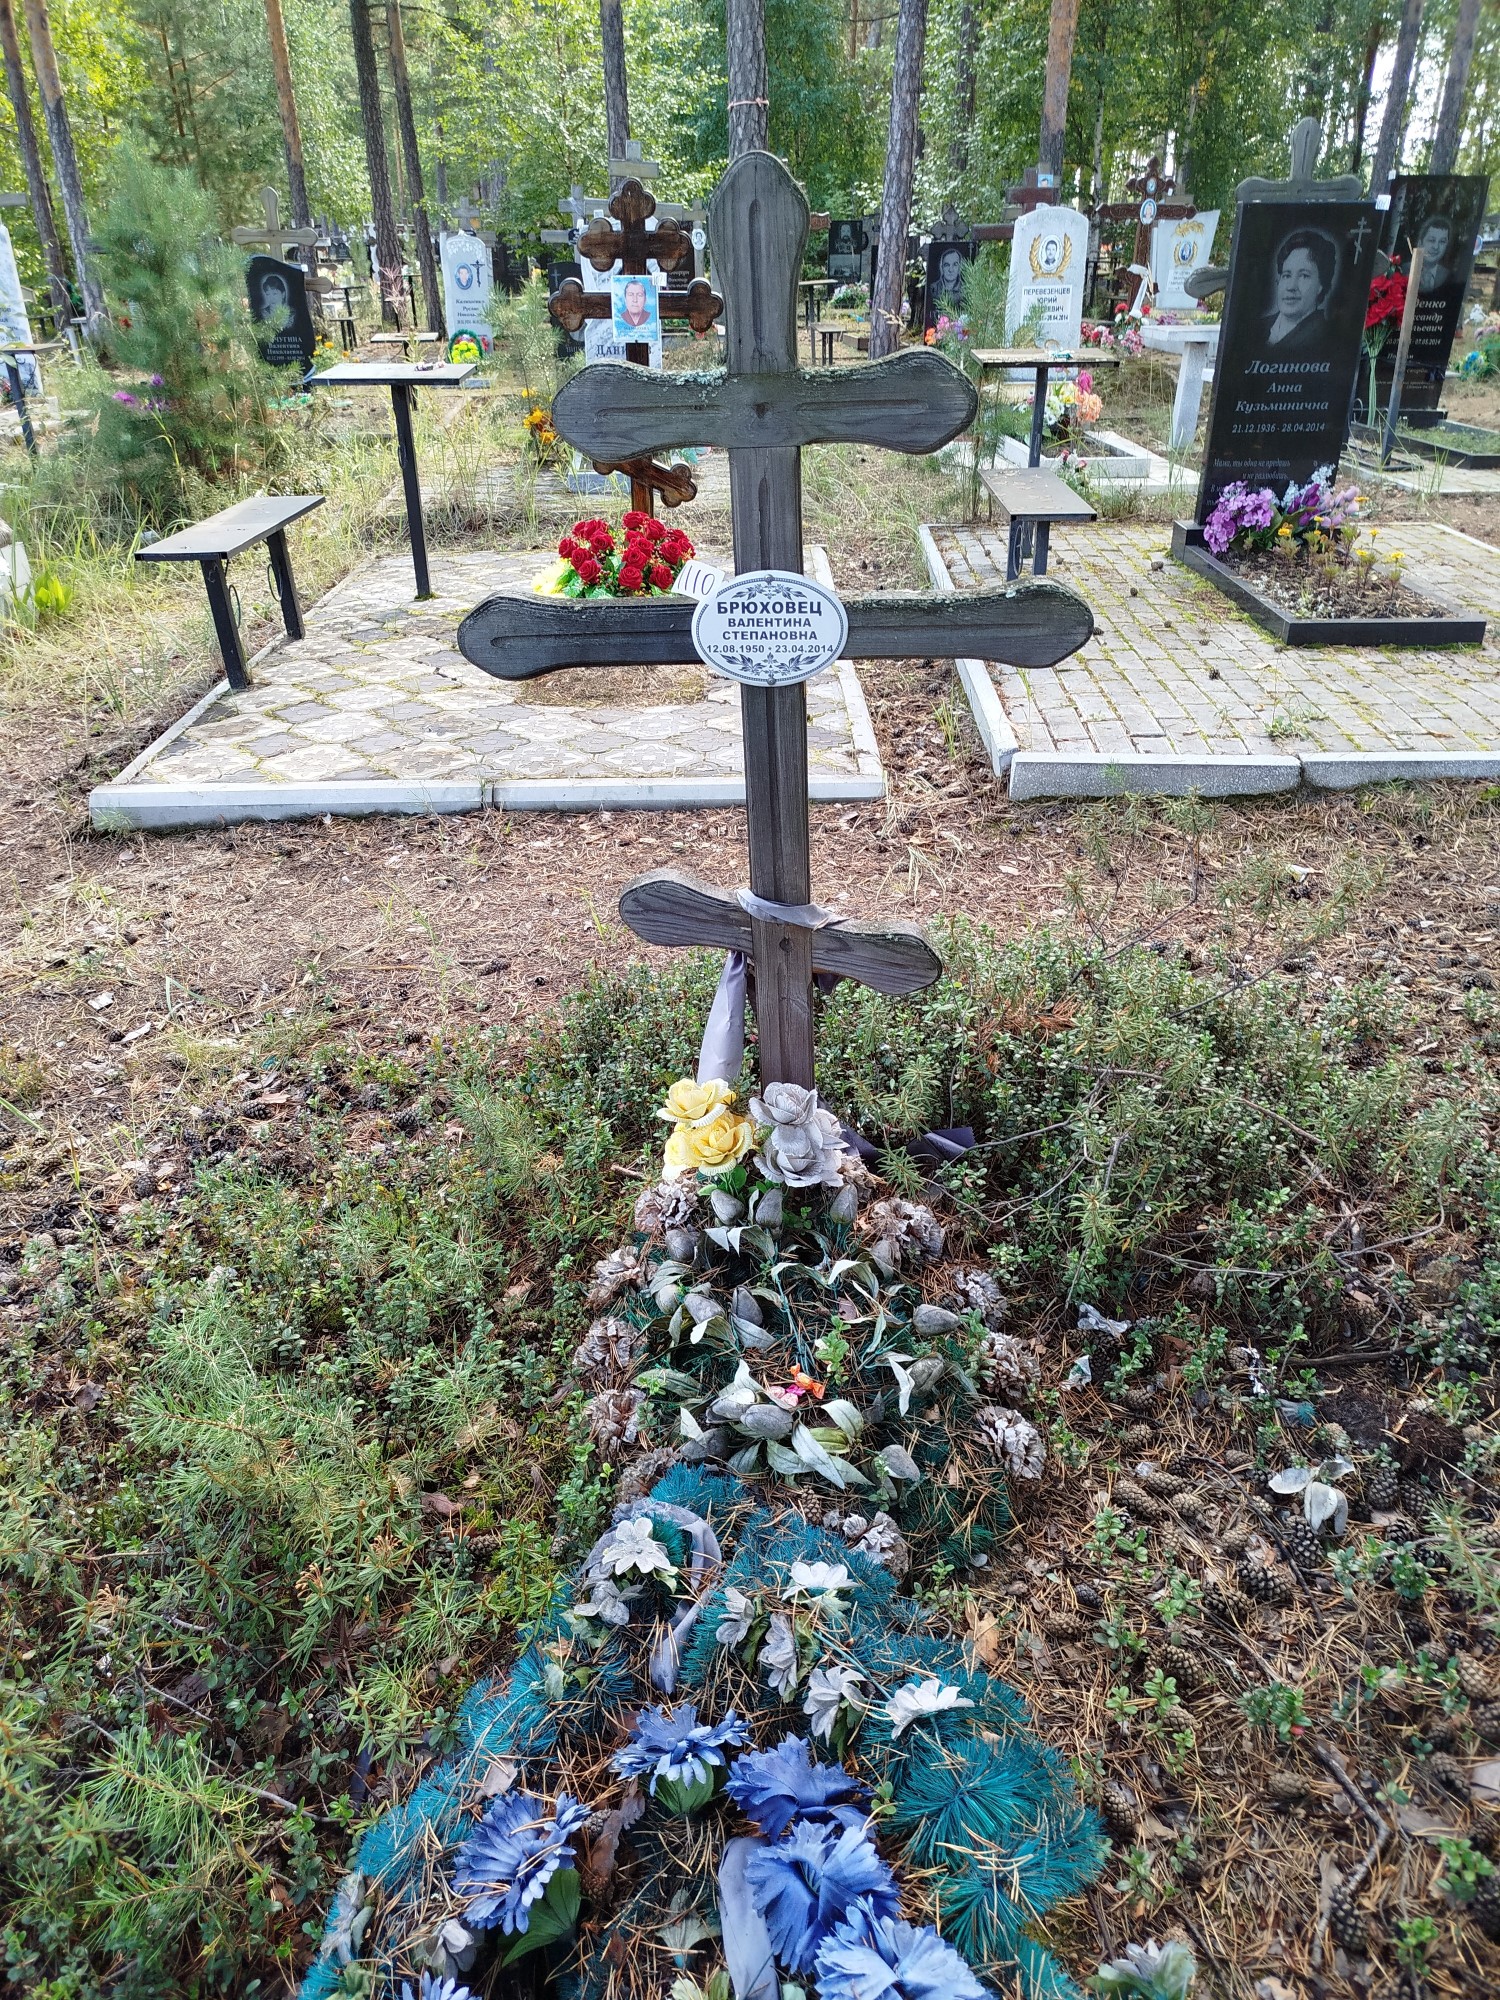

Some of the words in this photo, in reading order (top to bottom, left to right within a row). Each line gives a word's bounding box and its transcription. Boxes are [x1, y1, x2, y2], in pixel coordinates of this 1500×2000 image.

[1023, 287, 1071, 296] ПЕРЕВЕЗЕНЦЕВ
[1244, 360, 1331, 375] Логинова
[1266, 382, 1303, 393] Анна
[1235, 400, 1329, 414] Кузьминична
[1231, 424, 1276, 434] 21.12.1936
[1281, 422, 1326, 433] 28.04.2014
[717, 601, 823, 616] БРЮХОВЕЦ
[727, 617, 812, 628] ВАЛЕНТИНА
[722, 630, 818, 641] СТЕПАНОВНА
[706, 644, 765, 654] 12.08.1950
[775, 644, 834, 653] 23.04.2014
